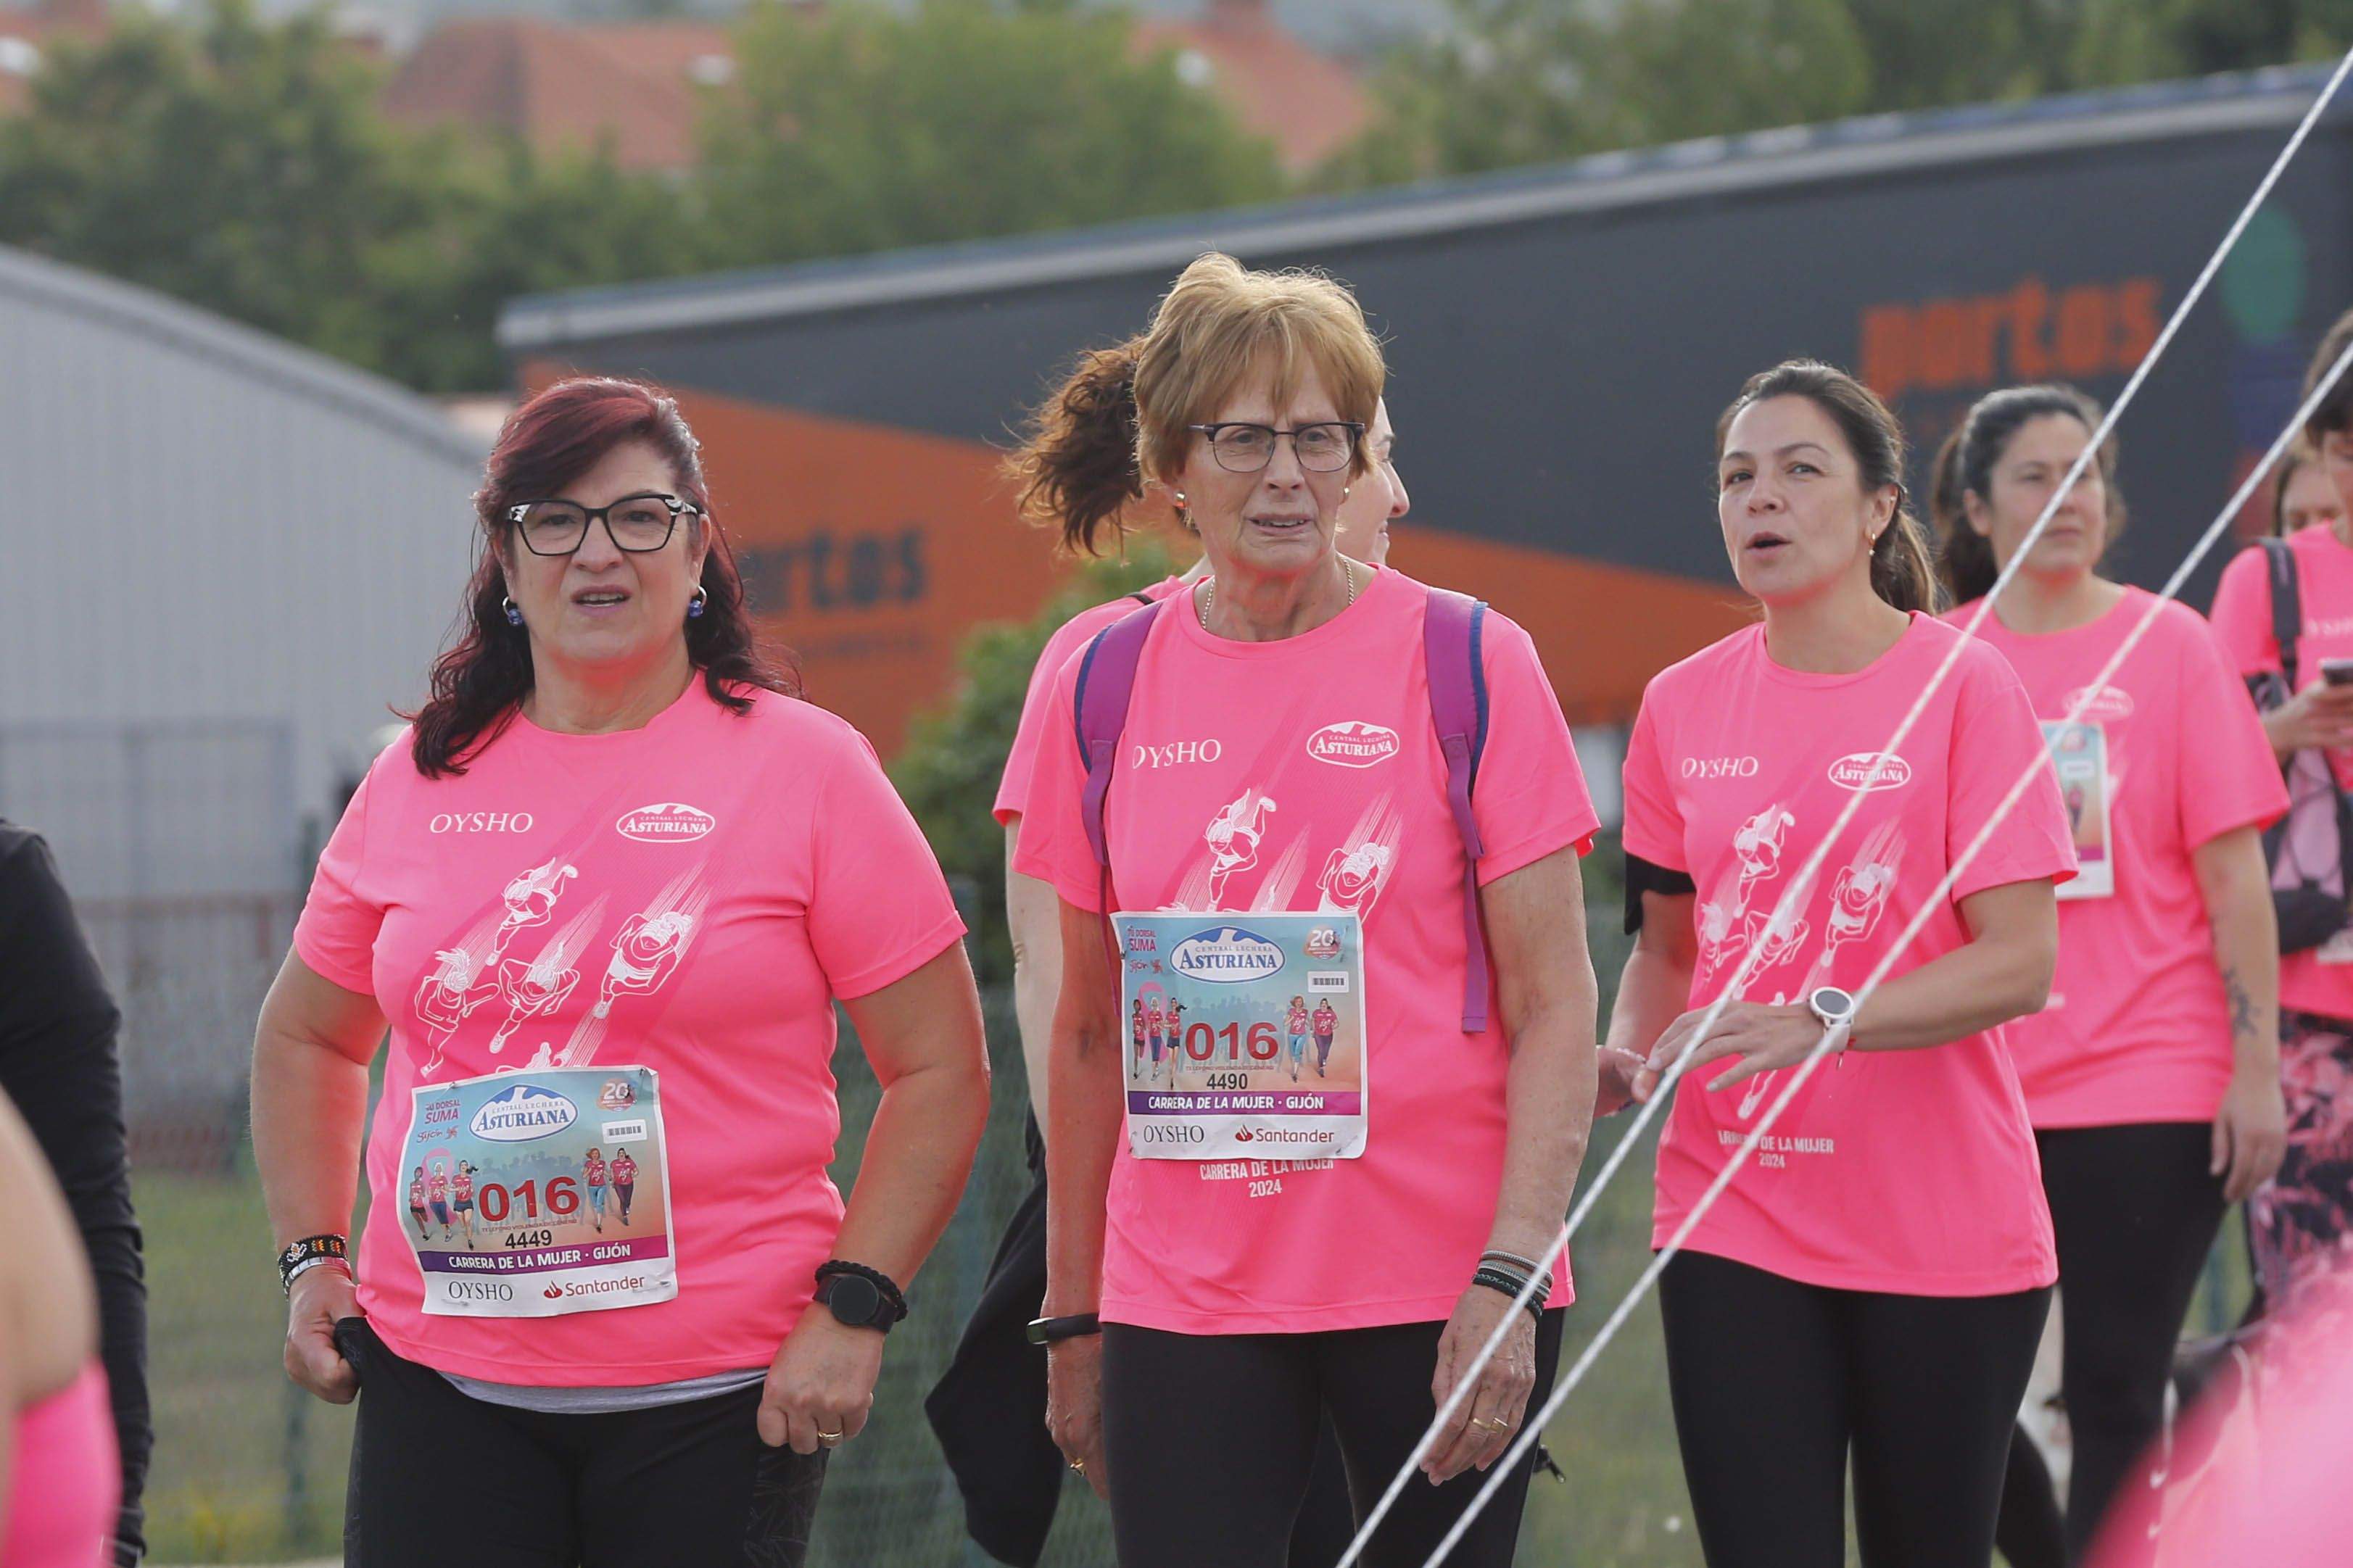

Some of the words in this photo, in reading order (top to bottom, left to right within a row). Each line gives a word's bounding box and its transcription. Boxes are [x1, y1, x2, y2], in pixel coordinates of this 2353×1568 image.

[1314, 736, 1393, 756] ASTURIANA
[1682, 756, 1758, 778] OYSHO
[1834, 765, 1903, 781] ASTUIANA
[430, 813, 533, 833] OYSHO
[622, 817, 707, 833] ASTURIANA
[1129, 938, 1157, 951] SUMA
[1179, 948, 1277, 969] ASTURIANA
[1186, 1022, 1278, 1061] 016
[1207, 1073, 1248, 1090] 4490
[604, 1083, 630, 1100] 20
[435, 1099, 461, 1110] DORSAL
[492, 1105, 522, 1113] CENTRAL
[525, 1101, 564, 1110] LECHERA
[1149, 1096, 1193, 1109] CARRERA
[1197, 1097, 1211, 1108] DE
[1215, 1097, 1228, 1108] LA
[1233, 1096, 1274, 1108] MUJER
[1286, 1093, 1323, 1109] GIJÓN
[424, 1108, 459, 1124] SUMA
[476, 1109, 569, 1132] ASTURIANA
[1144, 1125, 1204, 1142] OYSHO
[1256, 1128, 1334, 1142] Santander
[1761, 1135, 1775, 1150] DE
[1778, 1136, 1792, 1151] LA
[1795, 1137, 1834, 1153] MUJER
[1199, 1163, 1248, 1180] CARRERA
[1251, 1161, 1269, 1177] DE
[1273, 1159, 1289, 1174] LA
[1758, 1153, 1785, 1169] 2024
[1249, 1179, 1282, 1198] 2024
[479, 1177, 579, 1221] 016
[505, 1229, 552, 1248] 4449
[449, 1256, 496, 1269] CARRERA
[499, 1257, 514, 1269] DE
[517, 1255, 534, 1268] LA
[538, 1250, 581, 1266] MUJER
[593, 1243, 630, 1259] GIJÓN
[449, 1281, 513, 1301] OYSHO
[566, 1276, 645, 1296] Santander
